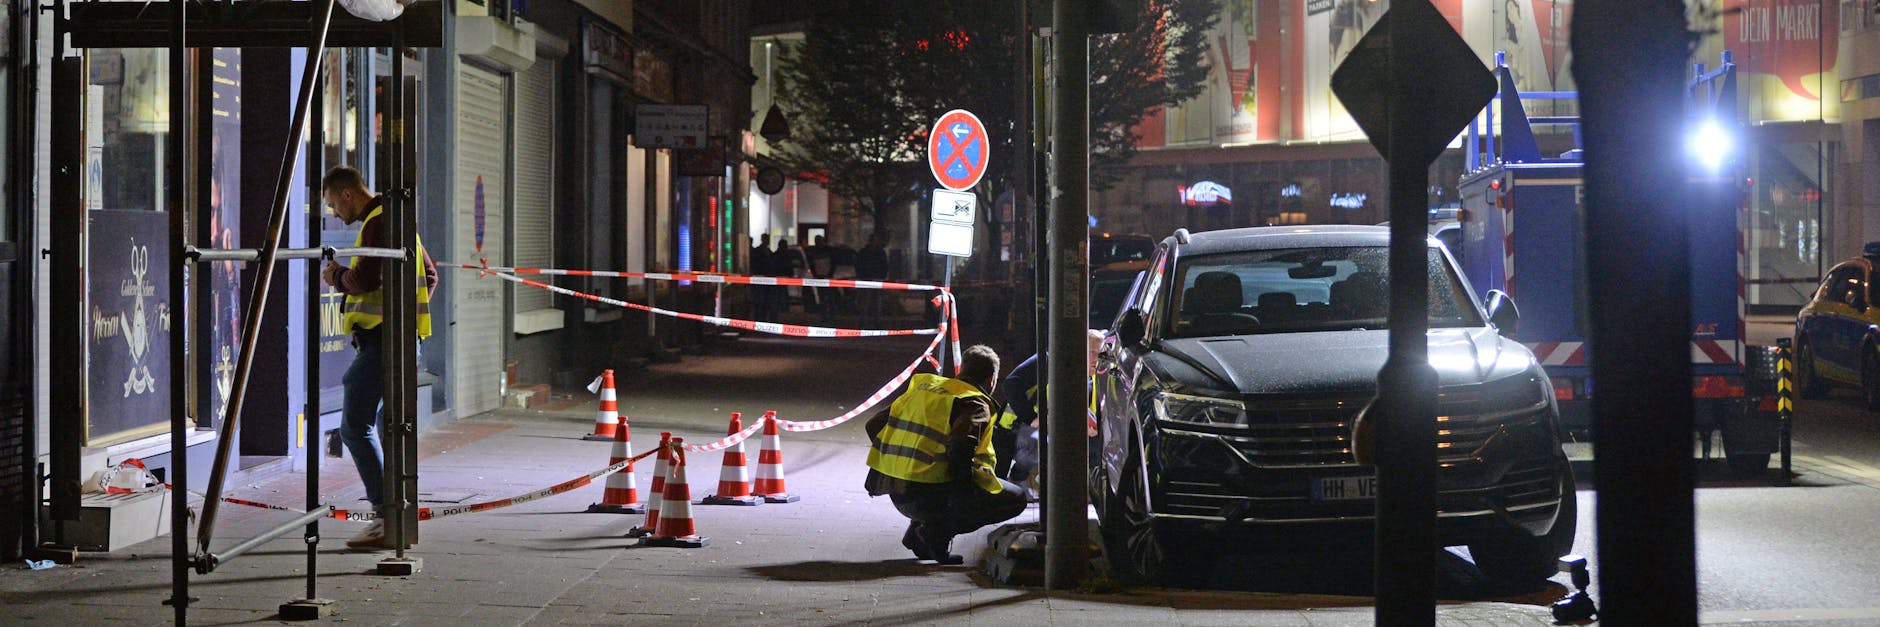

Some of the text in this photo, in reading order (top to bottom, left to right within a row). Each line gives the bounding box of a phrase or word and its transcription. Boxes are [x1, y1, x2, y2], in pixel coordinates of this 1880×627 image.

[1740, 4, 1820, 42] DEIN MARKT
[753, 323, 780, 332] POLIZEI
[1323, 479, 1345, 498] HH
[346, 511, 376, 521] POLIZ
